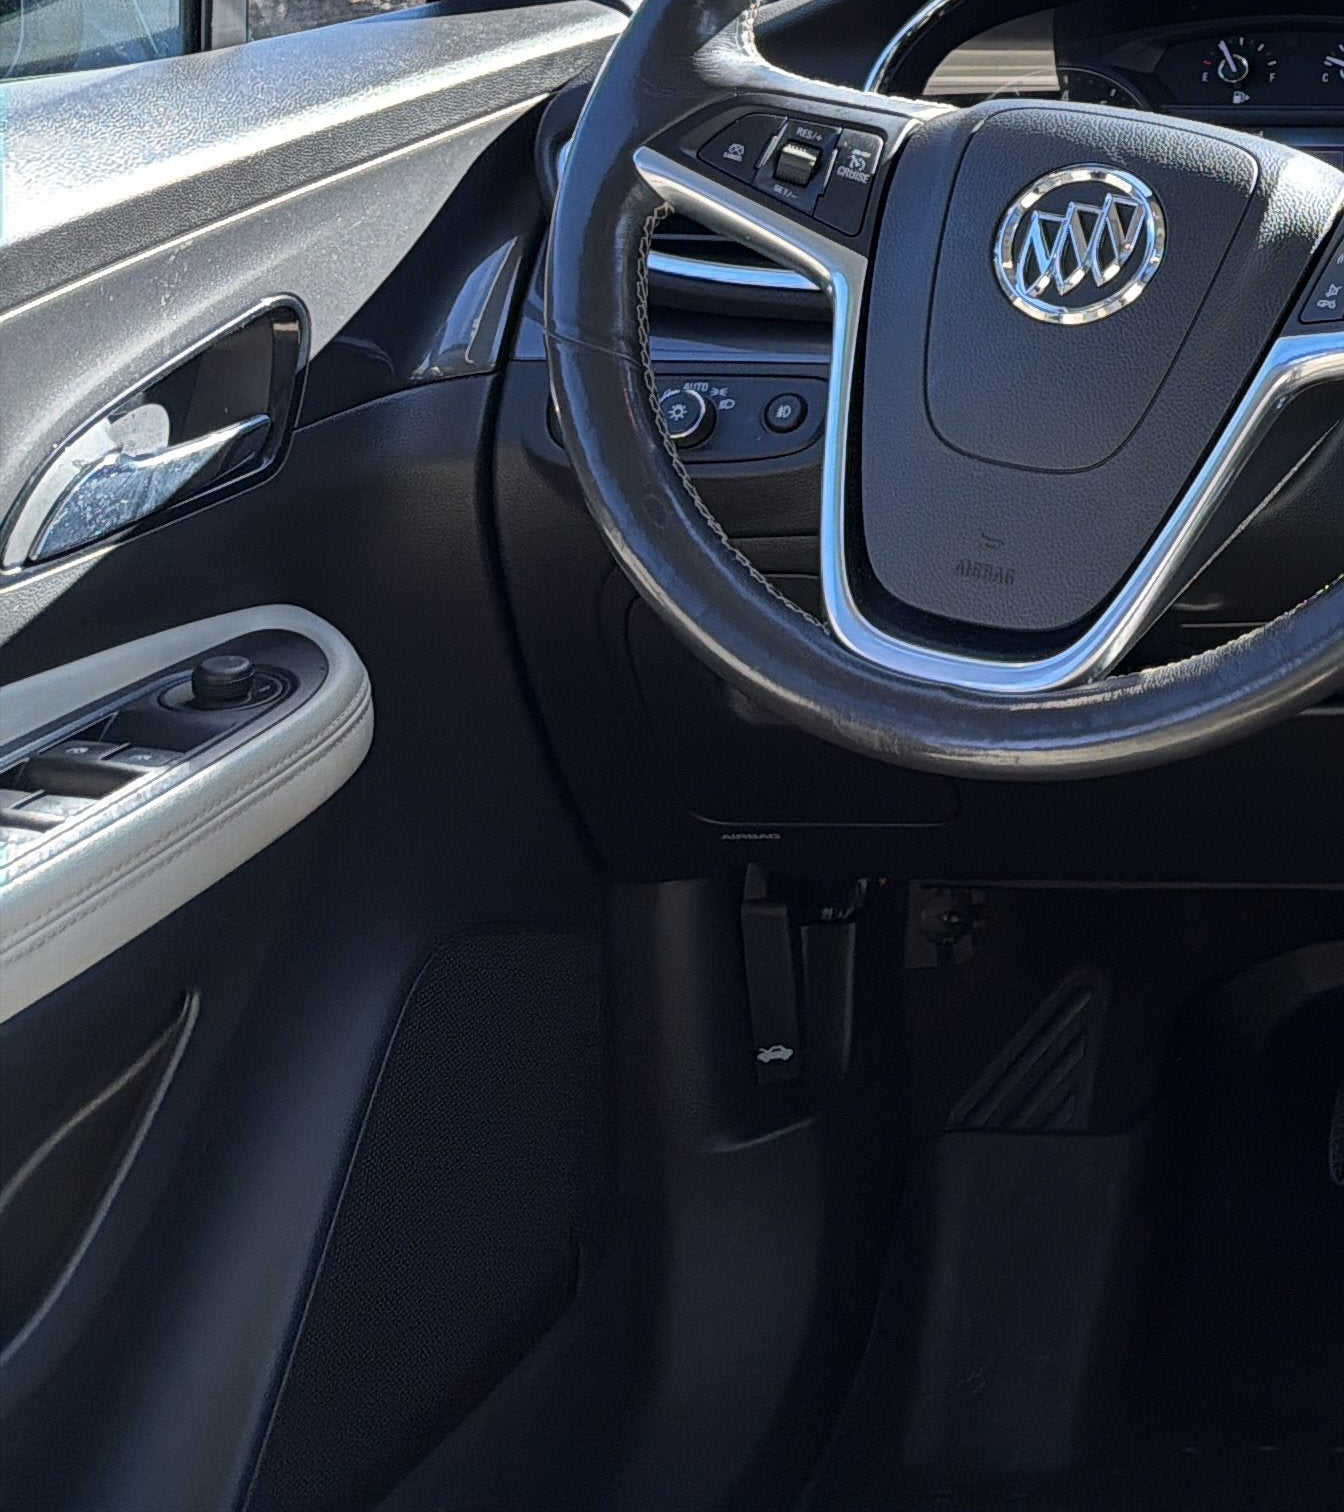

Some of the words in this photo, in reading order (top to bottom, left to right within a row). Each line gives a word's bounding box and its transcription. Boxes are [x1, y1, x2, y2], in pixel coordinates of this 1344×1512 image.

[1202, 72, 1208, 82] E
[1269, 72, 1276, 82] F
[1322, 72, 1329, 83] C
[797, 127, 822, 141] RES/+
[837, 166, 870, 184] CRUISE
